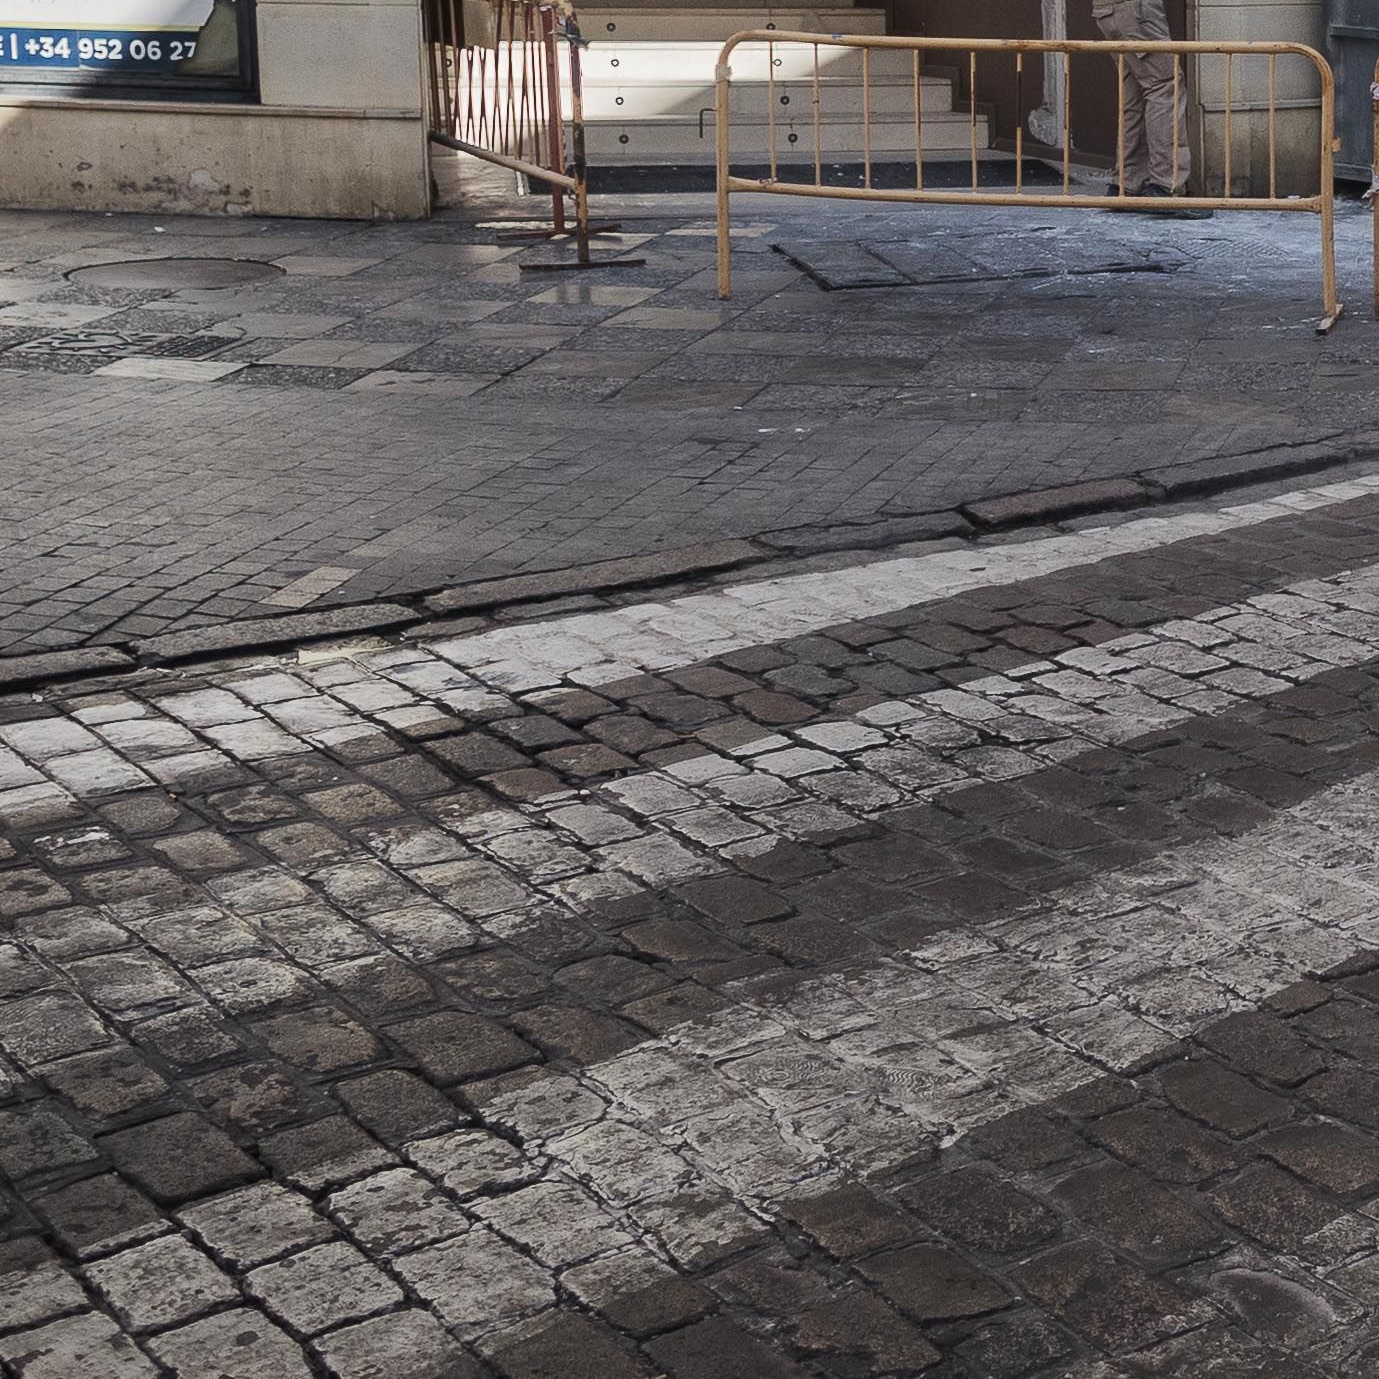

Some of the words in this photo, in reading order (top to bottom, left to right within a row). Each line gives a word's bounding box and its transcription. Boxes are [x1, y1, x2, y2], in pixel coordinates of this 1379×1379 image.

[24, 36, 71, 59] +34
[78, 37, 123, 60] 952
[129, 39, 162, 61] 06
[169, 41, 197, 61] 27
